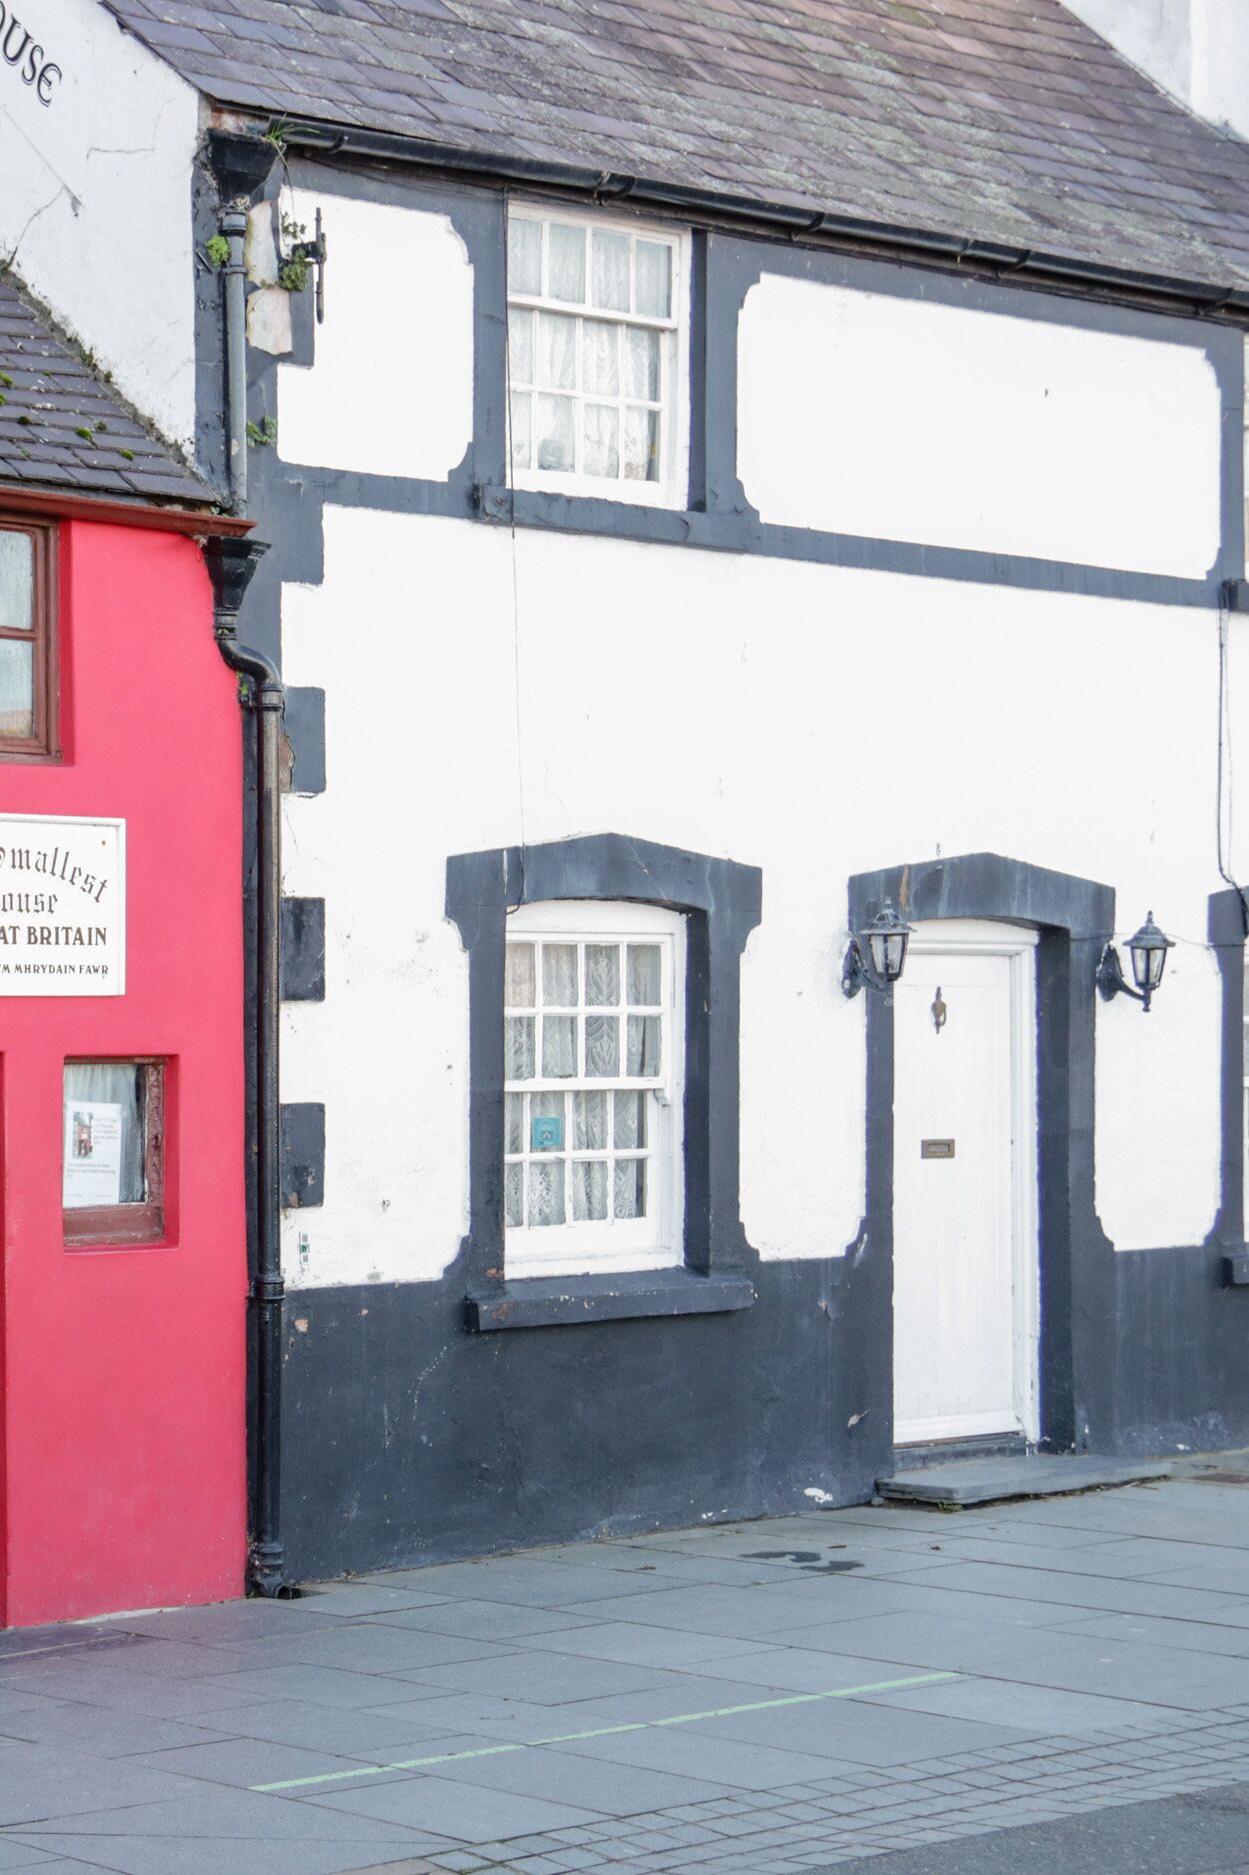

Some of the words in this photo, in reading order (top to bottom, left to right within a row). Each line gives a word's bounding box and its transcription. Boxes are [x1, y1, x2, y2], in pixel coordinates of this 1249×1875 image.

[26, 925, 107, 946] BRITAIN
[13, 963, 76, 975] MHRYDAIN
[78, 964, 109, 975] FAWR
